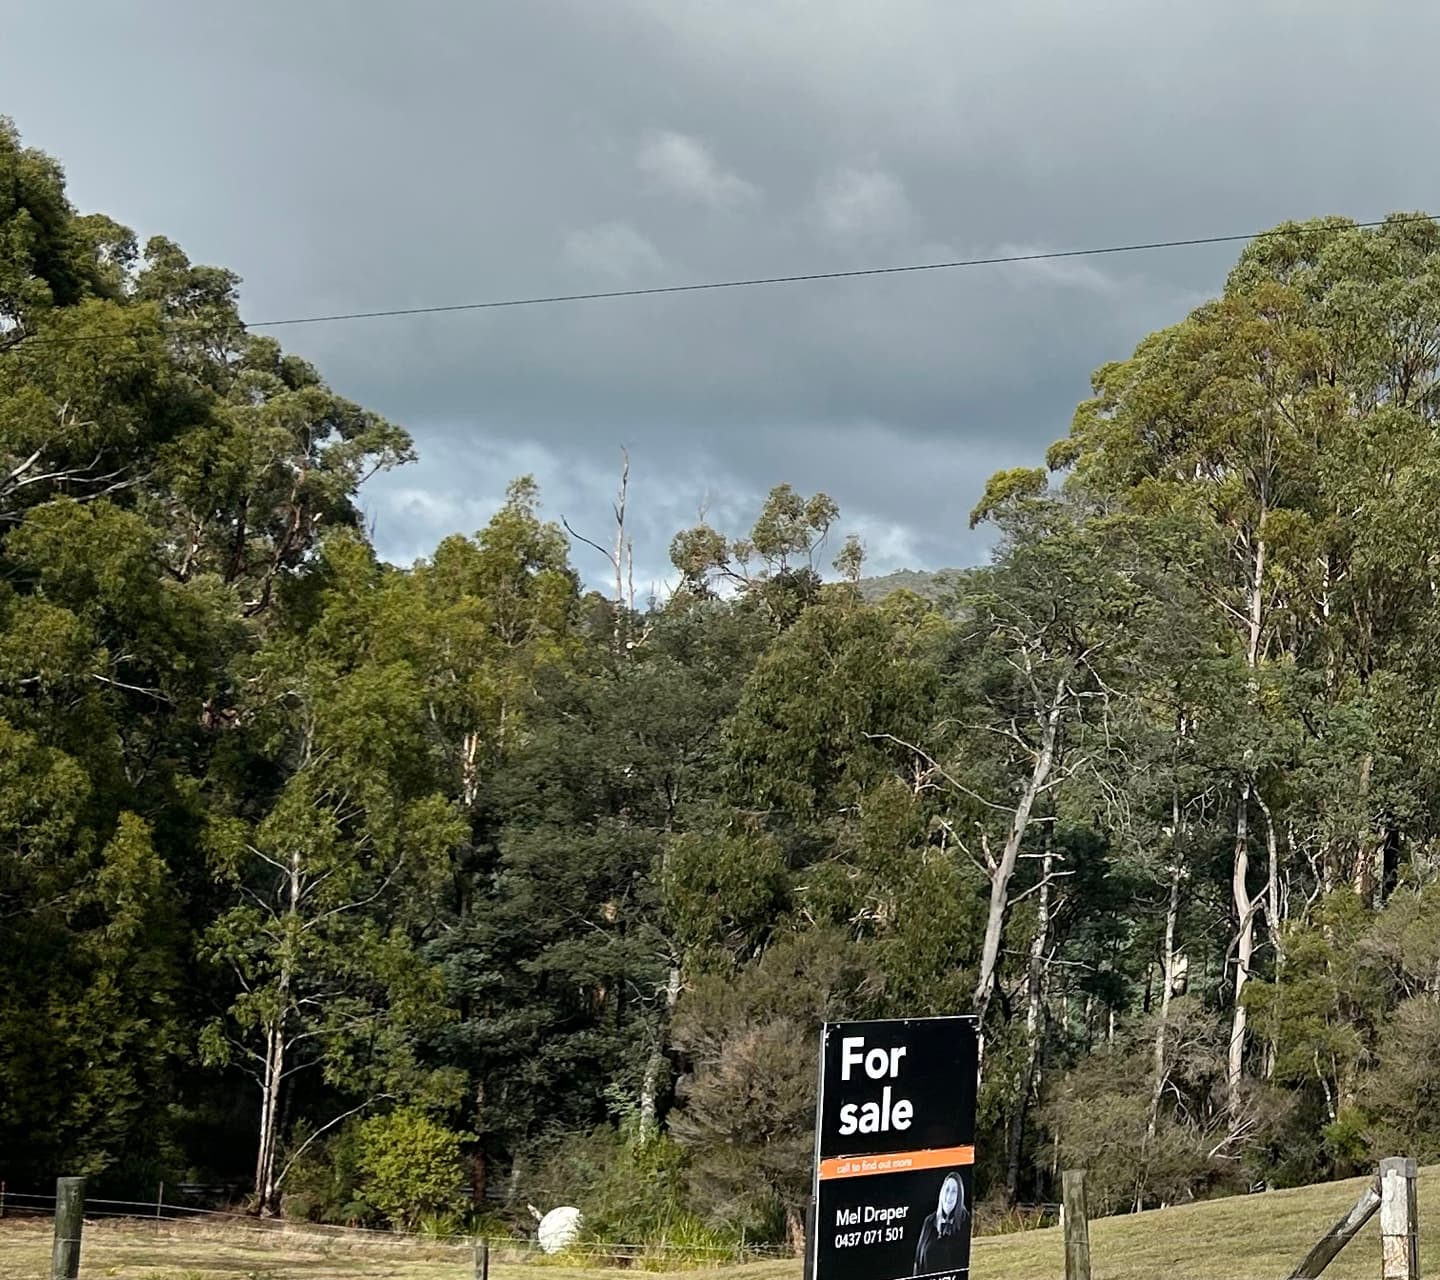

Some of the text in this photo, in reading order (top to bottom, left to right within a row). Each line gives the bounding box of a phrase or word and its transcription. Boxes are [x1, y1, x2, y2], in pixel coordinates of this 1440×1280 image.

[842, 1037, 906, 1080] For
[839, 1086, 913, 1135] sale
[851, 1163, 860, 1172] to
[862, 1159, 877, 1170] find
[836, 1206, 909, 1226] Mel Draper
[835, 1226, 903, 1248] 0437 071 501
